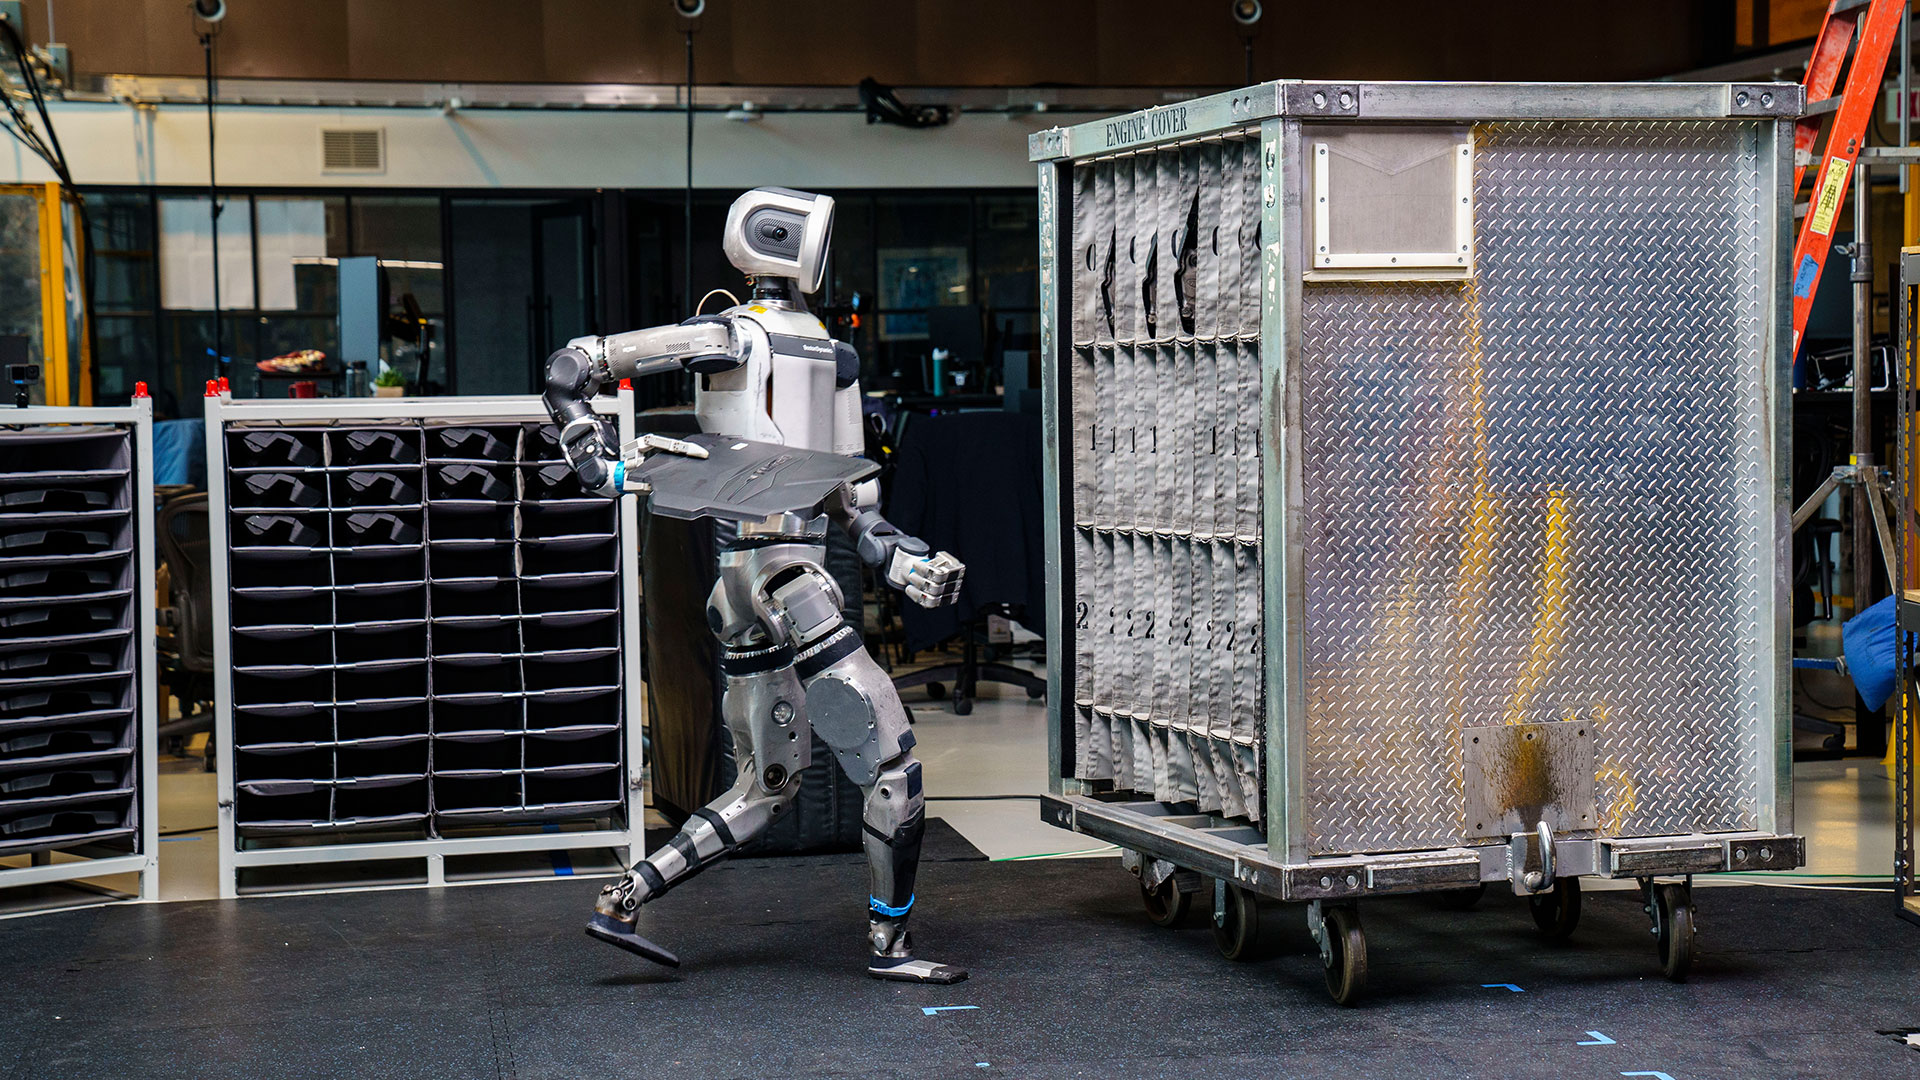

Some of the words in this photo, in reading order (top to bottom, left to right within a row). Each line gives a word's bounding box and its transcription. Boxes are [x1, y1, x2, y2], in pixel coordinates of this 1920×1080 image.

[1106, 116, 1146, 147] ENGINE
[1151, 106, 1187, 137] COVER
[1076, 601, 1088, 629] 2
